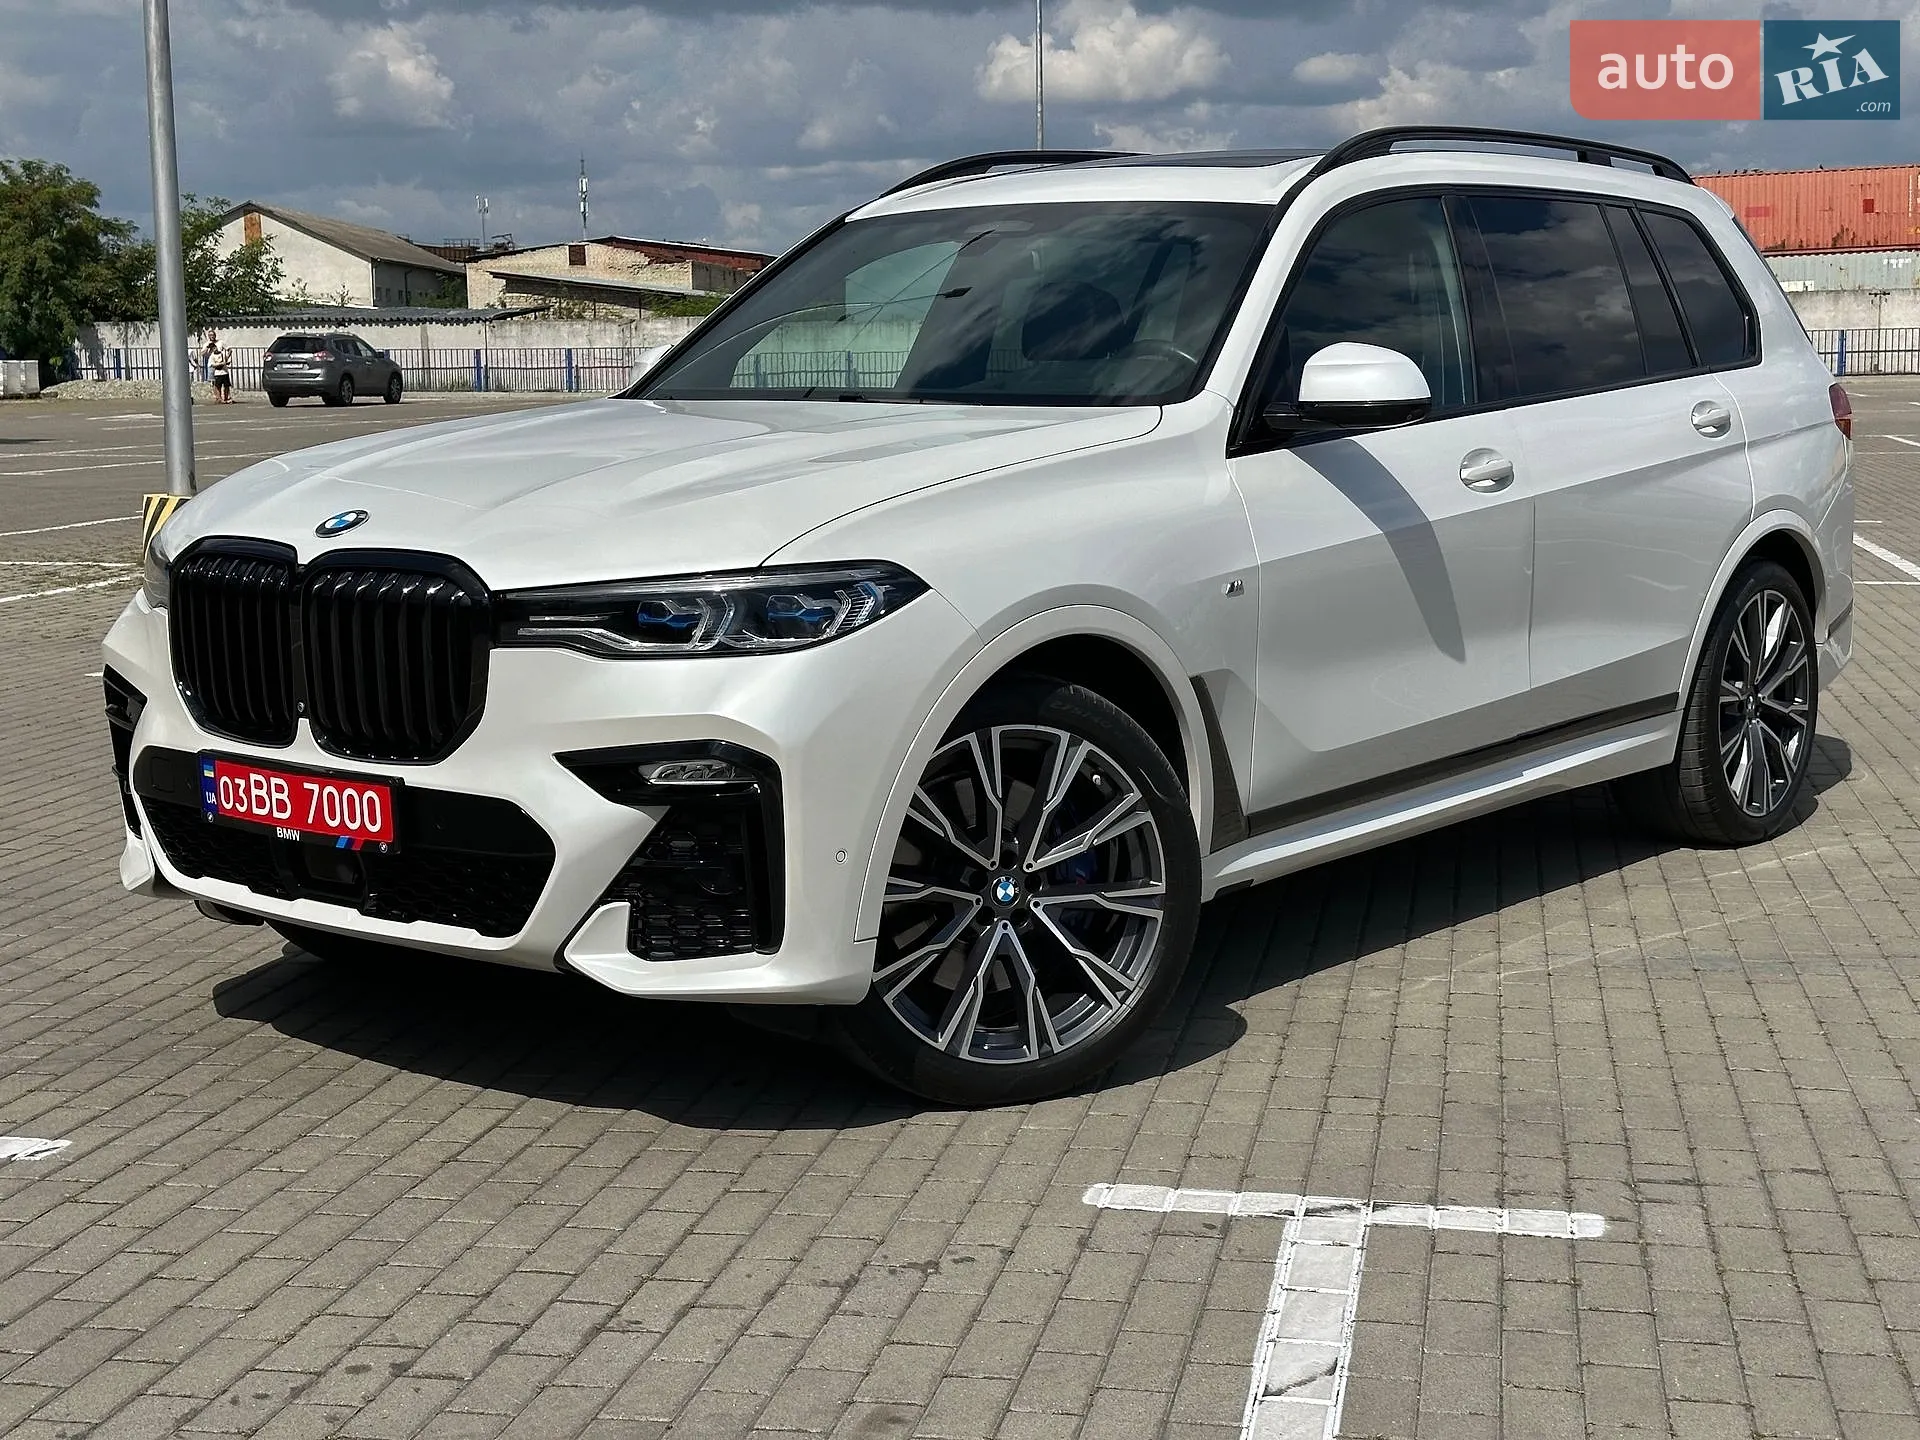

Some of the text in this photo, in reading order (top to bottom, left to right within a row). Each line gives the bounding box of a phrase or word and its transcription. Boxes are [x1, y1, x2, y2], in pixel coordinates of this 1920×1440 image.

[205, 791, 217, 805] UA
[219, 773, 382, 833] 03BB 7000
[276, 827, 300, 842] BMW
